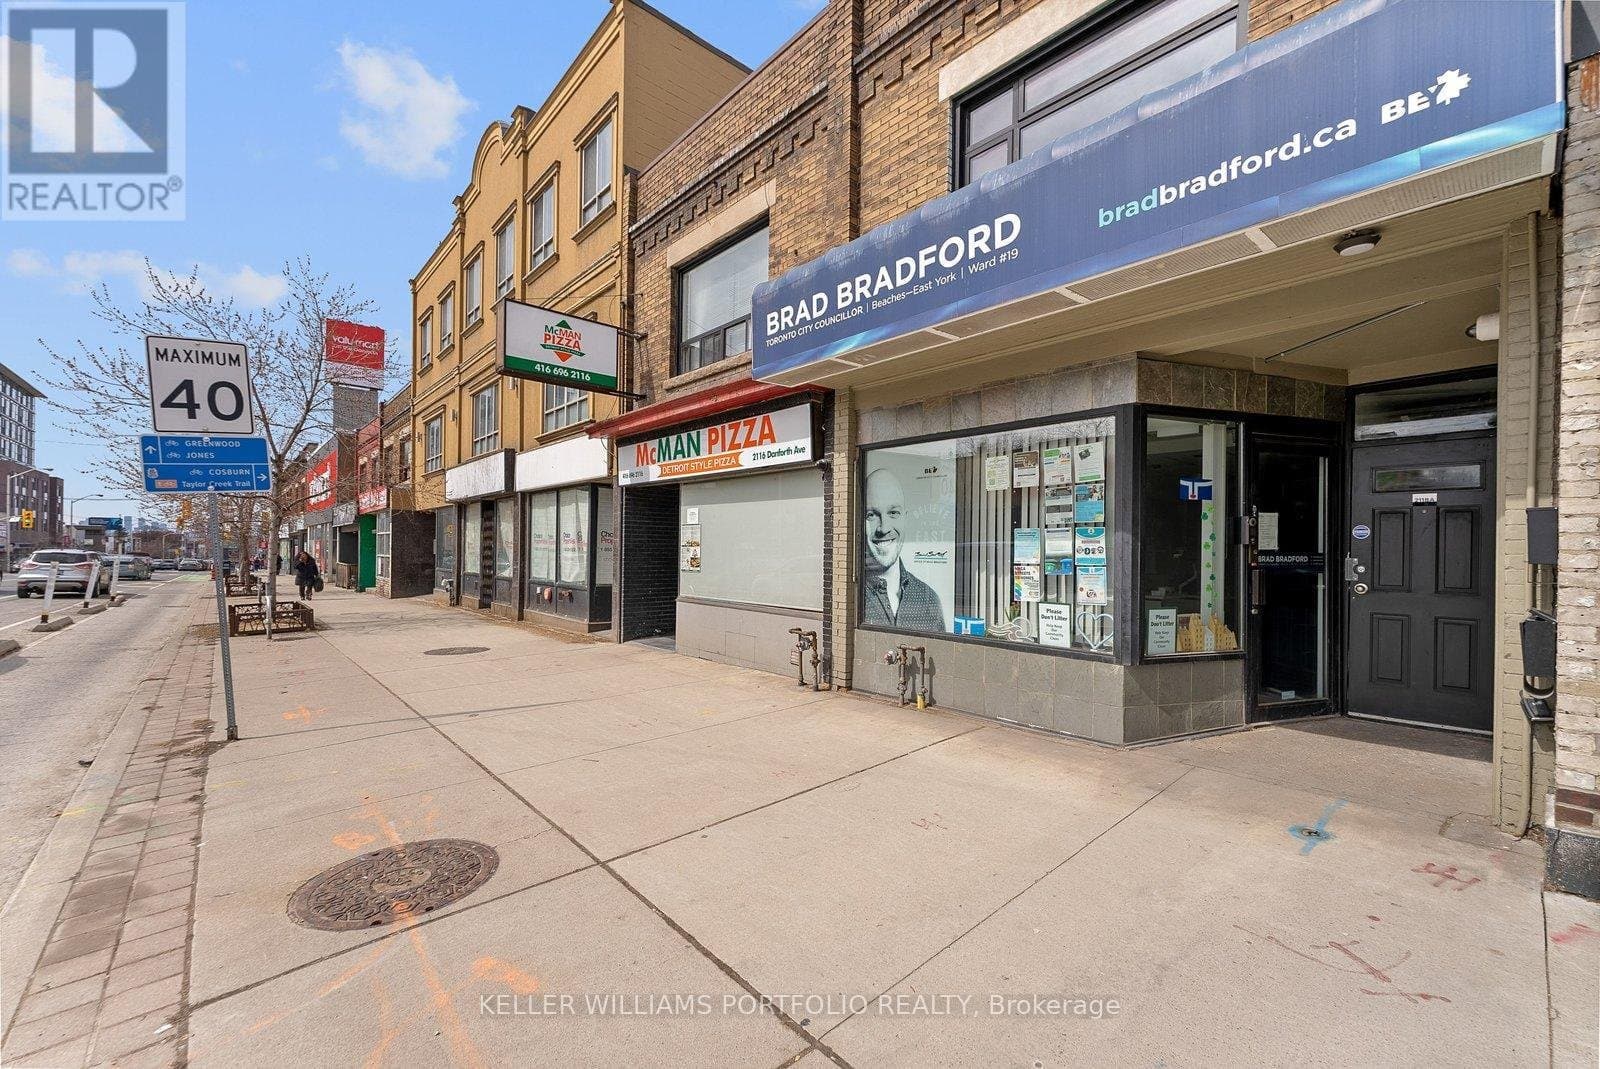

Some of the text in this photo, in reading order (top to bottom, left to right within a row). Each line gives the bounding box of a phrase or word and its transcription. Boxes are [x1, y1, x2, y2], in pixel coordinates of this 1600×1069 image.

[1097, 117, 1357, 228] bradbradford.ca
[766, 213, 1021, 336] BRAD BRADFORD
[765, 330, 797, 347] TORONTO
[798, 325, 813, 337] CITY
[814, 306, 863, 330] COUNCILLOR
[934, 271, 956, 287] York
[968, 256, 996, 275] Ward
[999, 248, 1019, 264] #19
[543, 332, 581, 351] PIZZA
[544, 324, 582, 341] McMAN
[155, 347, 241, 367] MAXIMUM
[534, 364, 591, 381] 416 696 2116
[160, 379, 244, 421] 40
[185, 440, 241, 448] GREENWOOD
[635, 414, 777, 468] McMAN PIZZA
[752, 446, 806, 461] 2116 Danforth Ave
[209, 468, 251, 476] COSBURN
[662, 457, 736, 475] DETROIT STYLE PIZZA
[182, 480, 206, 489] Taylor
[209, 480, 233, 488] Creek
[235, 480, 251, 488] Trail
